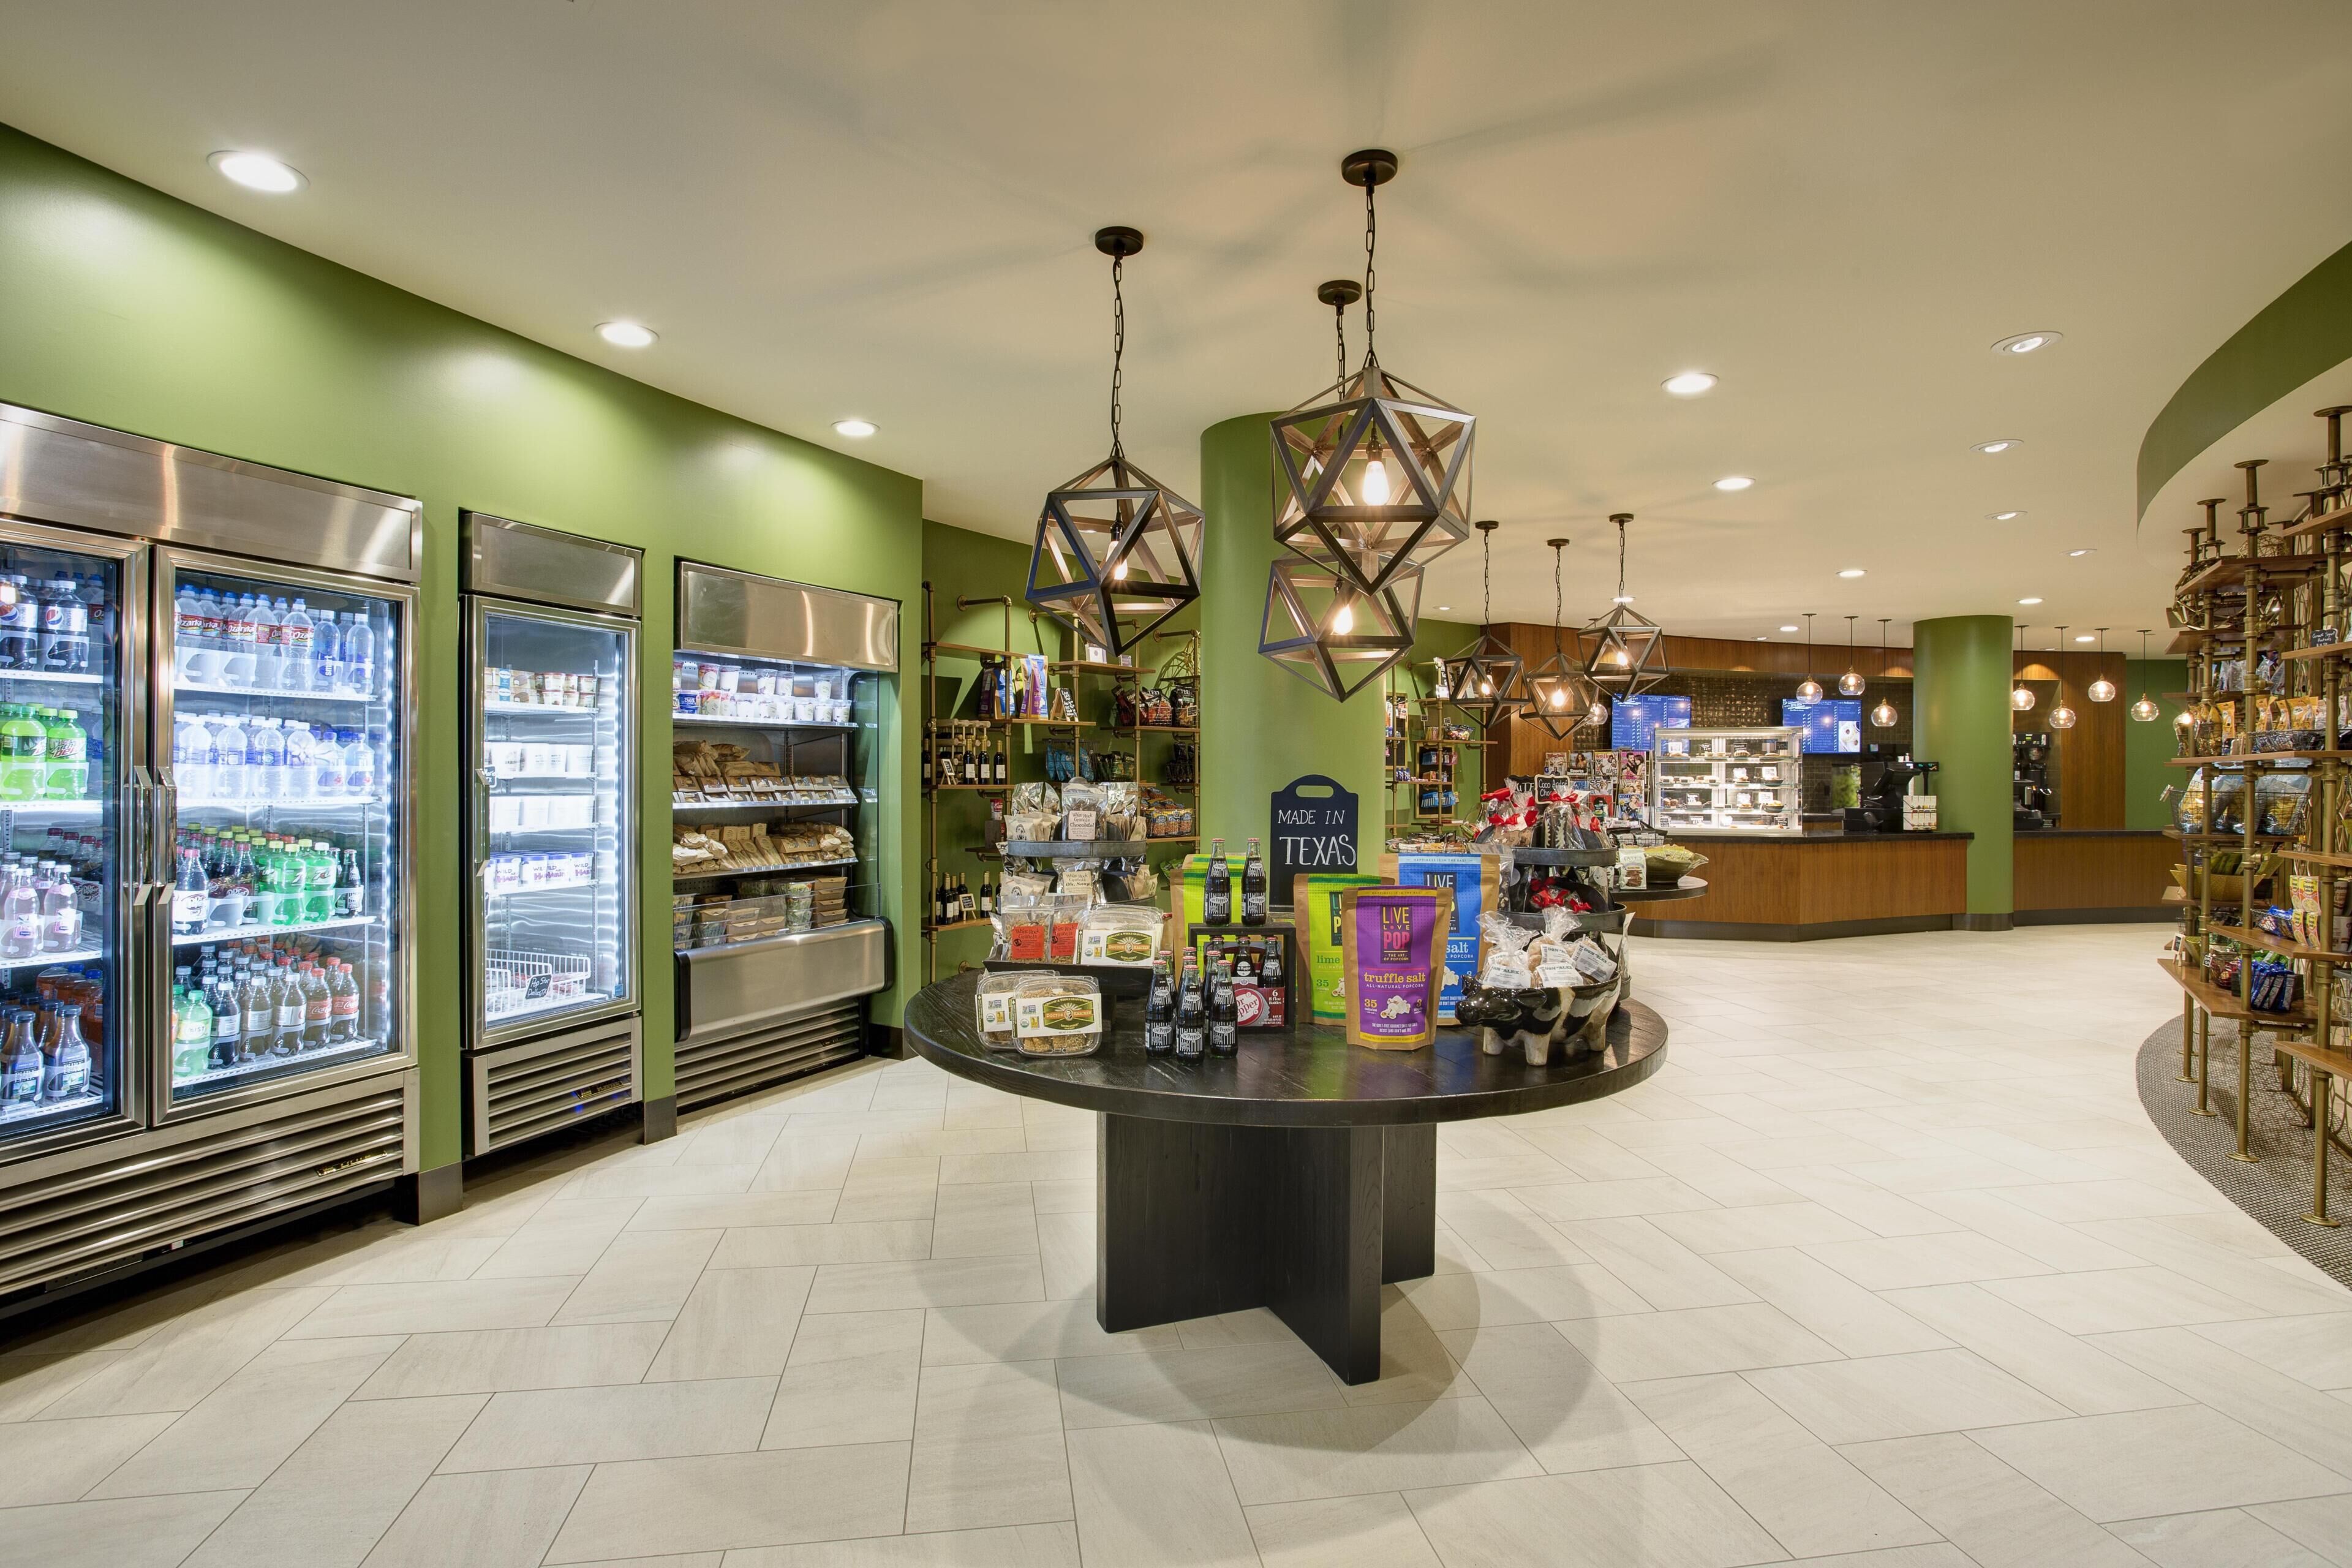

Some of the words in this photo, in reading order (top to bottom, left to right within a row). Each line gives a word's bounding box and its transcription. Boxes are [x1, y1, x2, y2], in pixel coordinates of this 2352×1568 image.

[1539, 779, 1551, 789] Coco
[1278, 809, 1316, 824] MADE
[1325, 810, 1345, 824] IN
[1279, 834, 1356, 866] TEXAS
[1383, 907, 1409, 924] LIVE
[1384, 932, 1410, 949] POP
[1446, 942, 1469, 953] salt
[1364, 972, 1404, 984] truffle
[1406, 972, 1426, 983] salt
[1365, 998, 1378, 1008] 35
